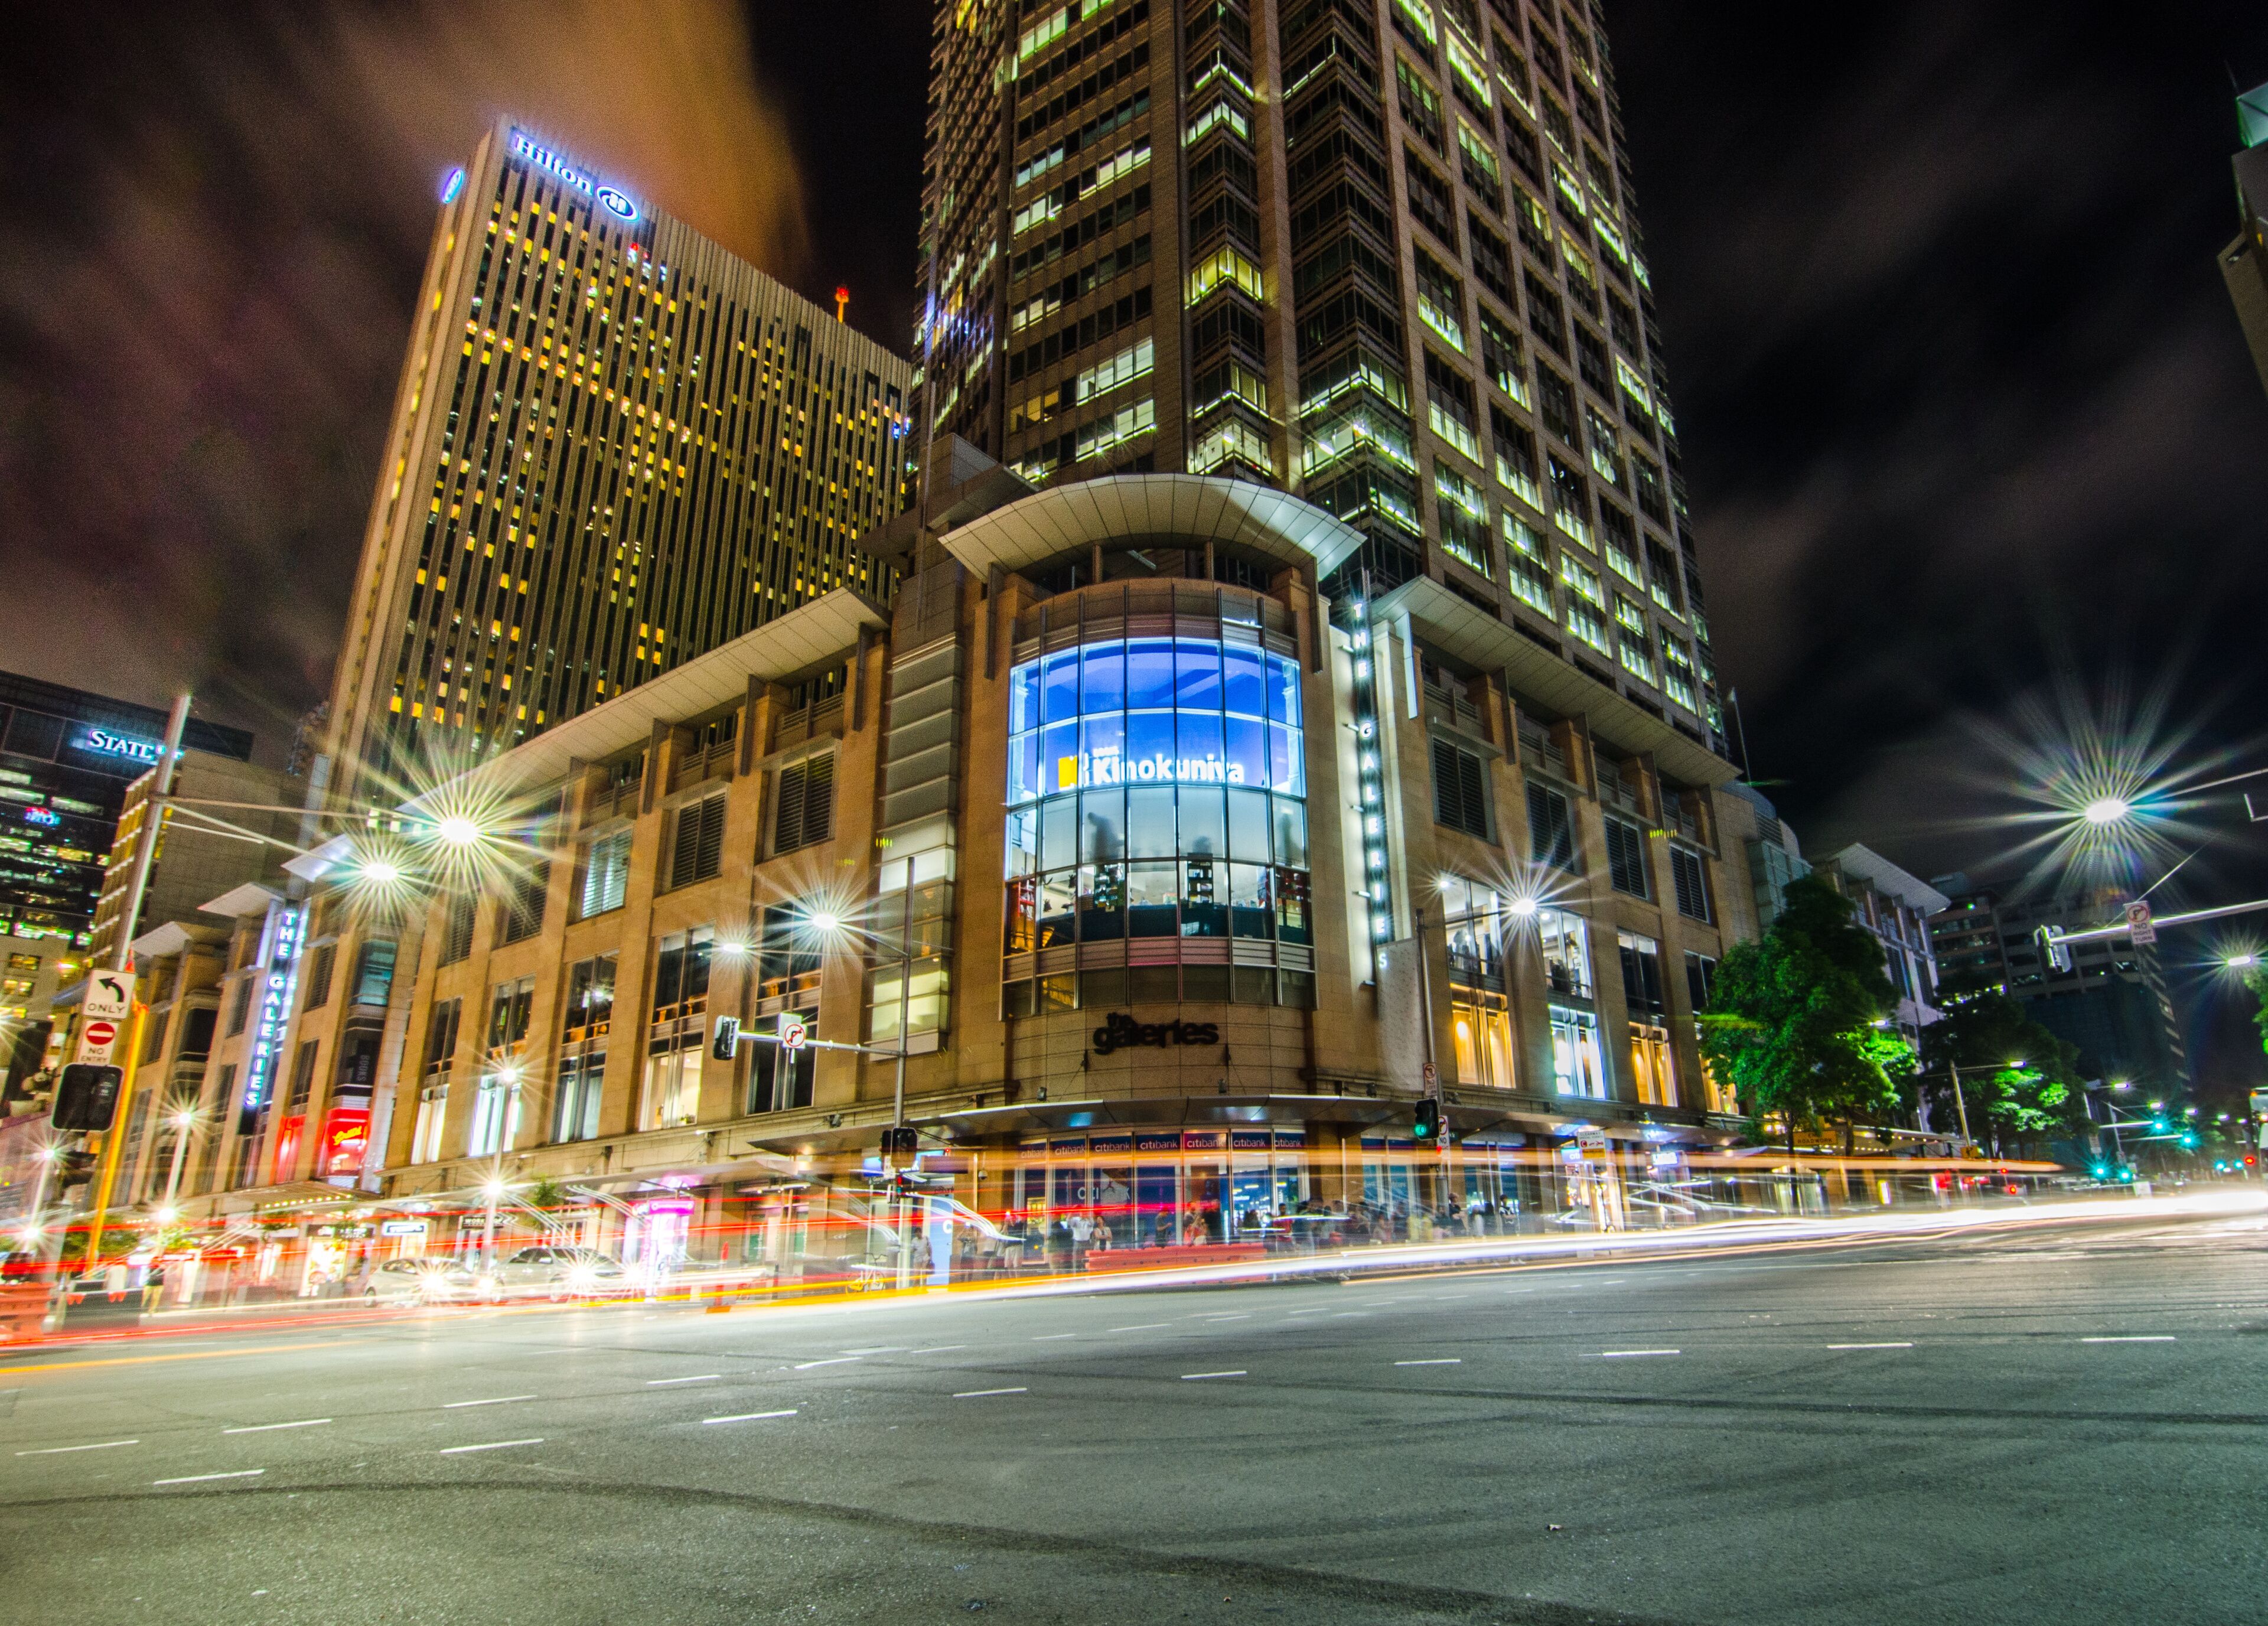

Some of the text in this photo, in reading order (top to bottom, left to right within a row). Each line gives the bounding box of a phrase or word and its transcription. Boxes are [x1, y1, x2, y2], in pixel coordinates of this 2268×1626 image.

[515, 135, 593, 195] Hilton
[1093, 754, 1244, 784] Kinokuniya
[1353, 602, 1387, 969] THE GALERIES
[87, 1003, 125, 1014] ONLY
[245, 911, 297, 1106] THE GALERIES
[1094, 1142, 1130, 1152] citibank
[1140, 1139, 1178, 1150] citibank
[1187, 1138, 1223, 1148] citibank
[1233, 1138, 1266, 1148] citibank
[1274, 1138, 1302, 1148] citibank
[1054, 1144, 1086, 1156] citibank
